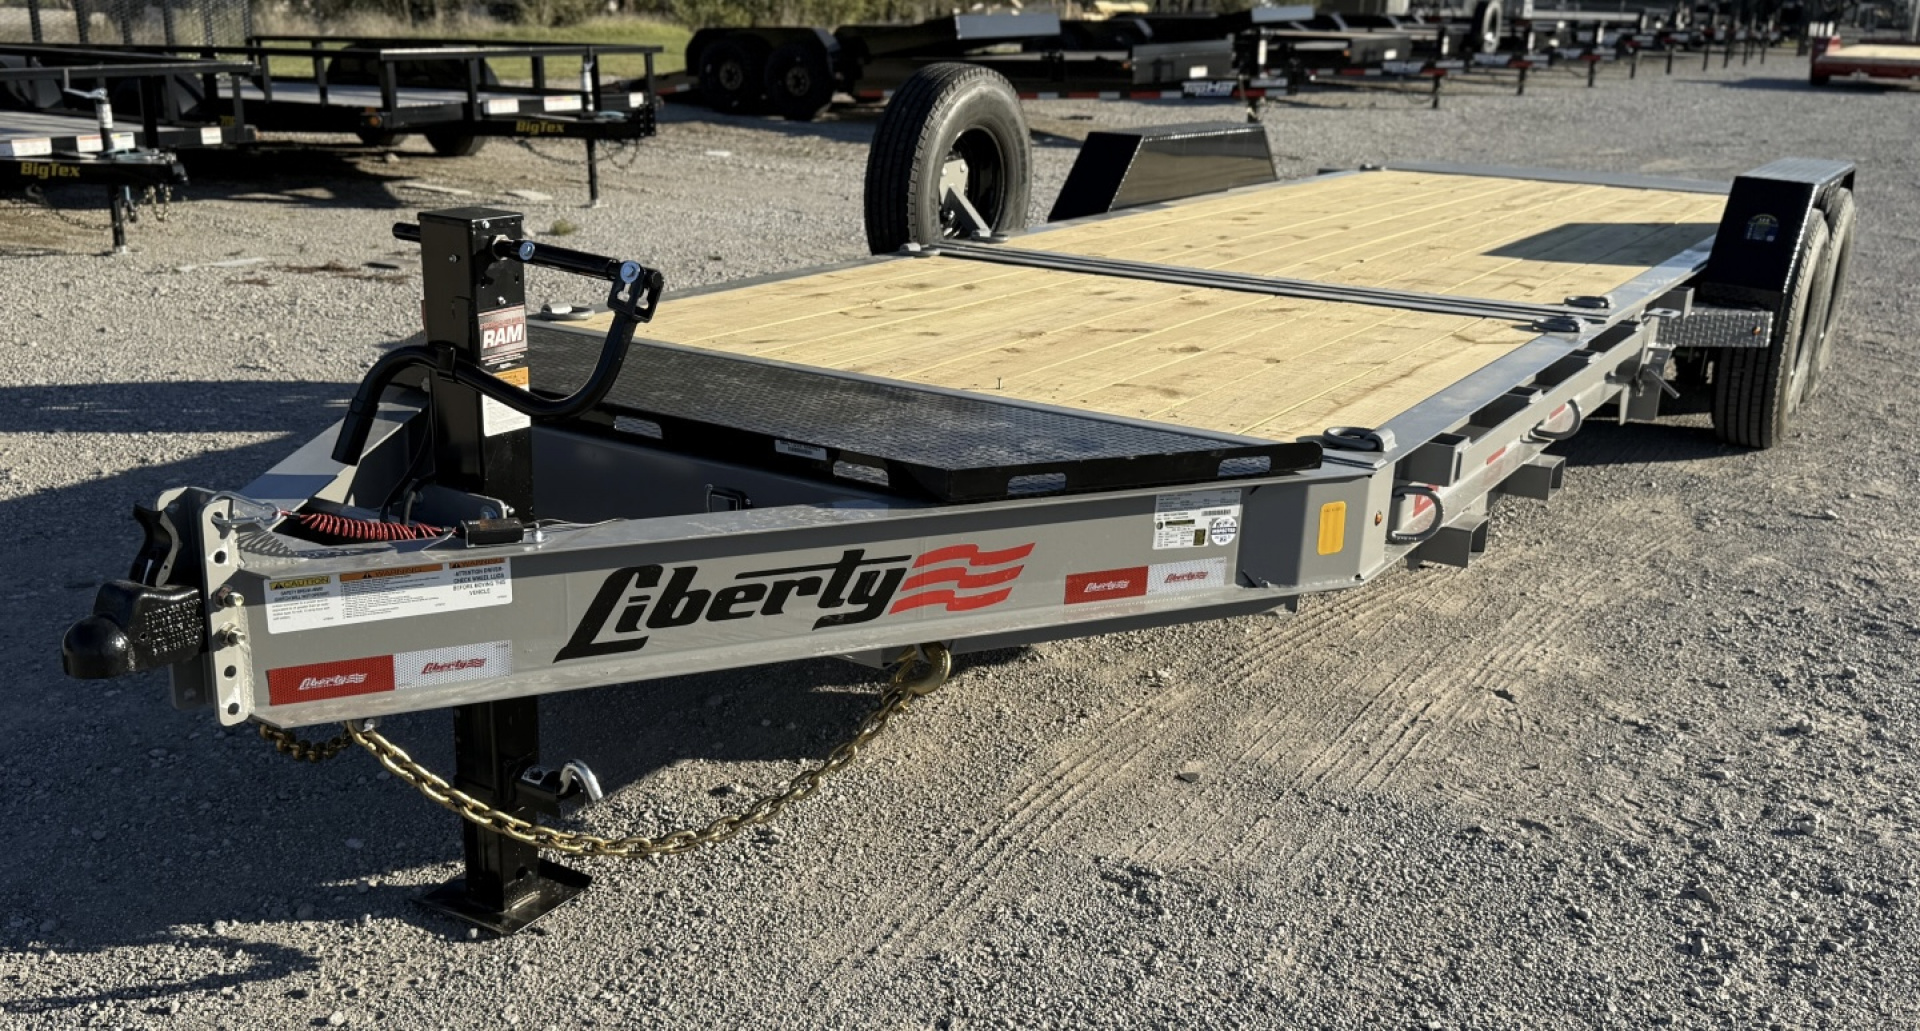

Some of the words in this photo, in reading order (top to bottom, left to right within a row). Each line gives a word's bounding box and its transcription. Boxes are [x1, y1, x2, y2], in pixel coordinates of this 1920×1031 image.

[516, 120, 565, 135] BigTex
[20, 162, 80, 179] BigTex
[483, 324, 524, 349] RAM
[283, 576, 329, 588] CAUTION
[1164, 572, 1195, 583] Liberty
[453, 583, 473, 591] BEFORE
[1084, 581, 1118, 592] Liberty
[552, 548, 912, 663] Liberty
[421, 660, 467, 674] Liberty
[298, 674, 346, 691] Liberty
